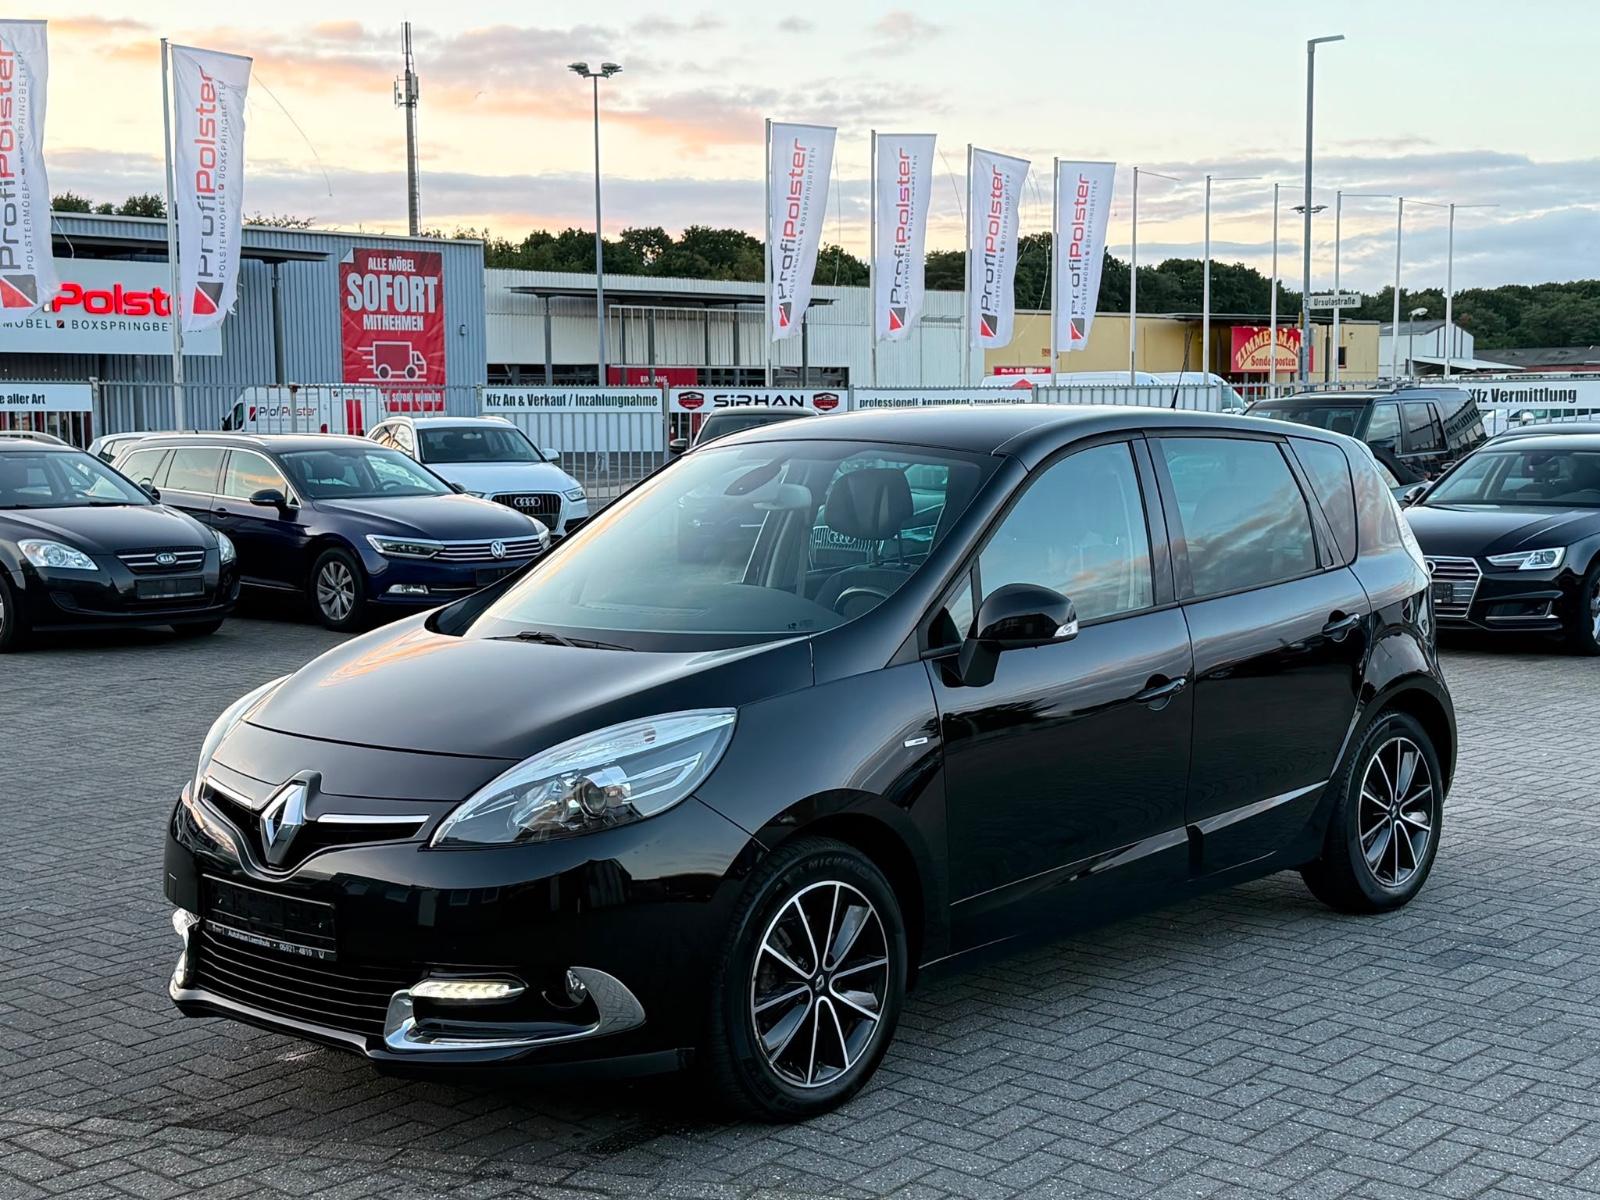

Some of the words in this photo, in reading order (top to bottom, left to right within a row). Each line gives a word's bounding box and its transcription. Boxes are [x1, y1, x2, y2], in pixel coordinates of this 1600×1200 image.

[194, 65, 216, 277] ProfiPolster
[778, 137, 807, 300] ProfiPolster
[890, 147, 910, 305] ProfiPolster
[981, 164, 1003, 311] ProfiPolster
[1069, 173, 1090, 315] ProfiPolster
[368, 257, 387, 270] ALLE
[388, 255, 416, 272] MÖBEL
[53, 283, 172, 317] Polst
[346, 272, 438, 313] SOFORT
[72, 319, 172, 332] BOXSPRINGBE
[363, 314, 424, 331] MITNEHMEN
[1251, 355, 1296, 368] Sondeposten
[640, 375, 668, 383] EINANG
[7, 393, 30, 404] aller
[31, 393, 46, 404] Art
[486, 393, 500, 407] Kfz
[503, 393, 516, 407] An
[518, 395, 525, 407] &
[527, 393, 567, 407] Verkauf
[575, 393, 658, 408] Inzahlungnahme
[859, 397, 918, 408] professionell
[1491, 387, 1577, 404] Vermittlung
